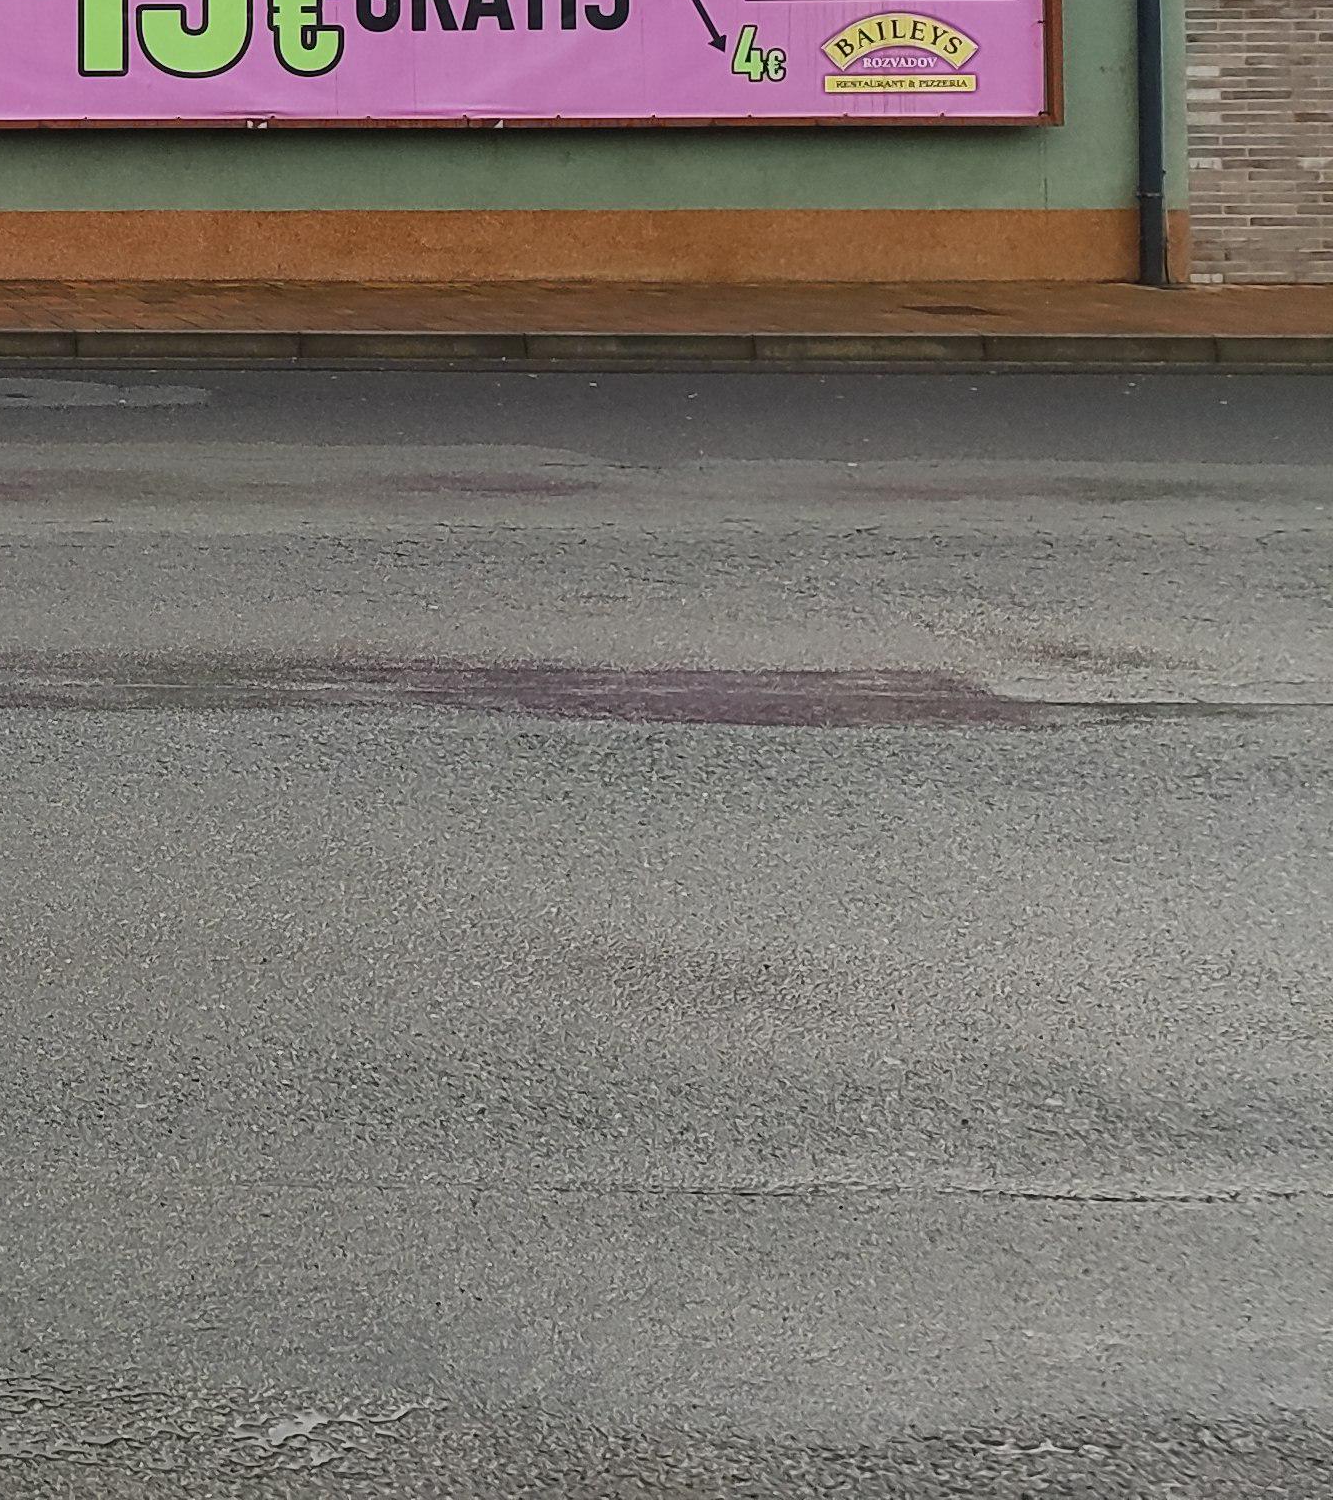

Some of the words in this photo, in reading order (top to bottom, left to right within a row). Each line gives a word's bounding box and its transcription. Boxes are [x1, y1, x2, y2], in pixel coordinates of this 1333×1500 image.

[833, 18, 963, 59] BAILEYS
[862, 56, 938, 69] ROZVADOV
[835, 79, 905, 89] RESTAURANT
[919, 78, 969, 88] PIZZERIA
